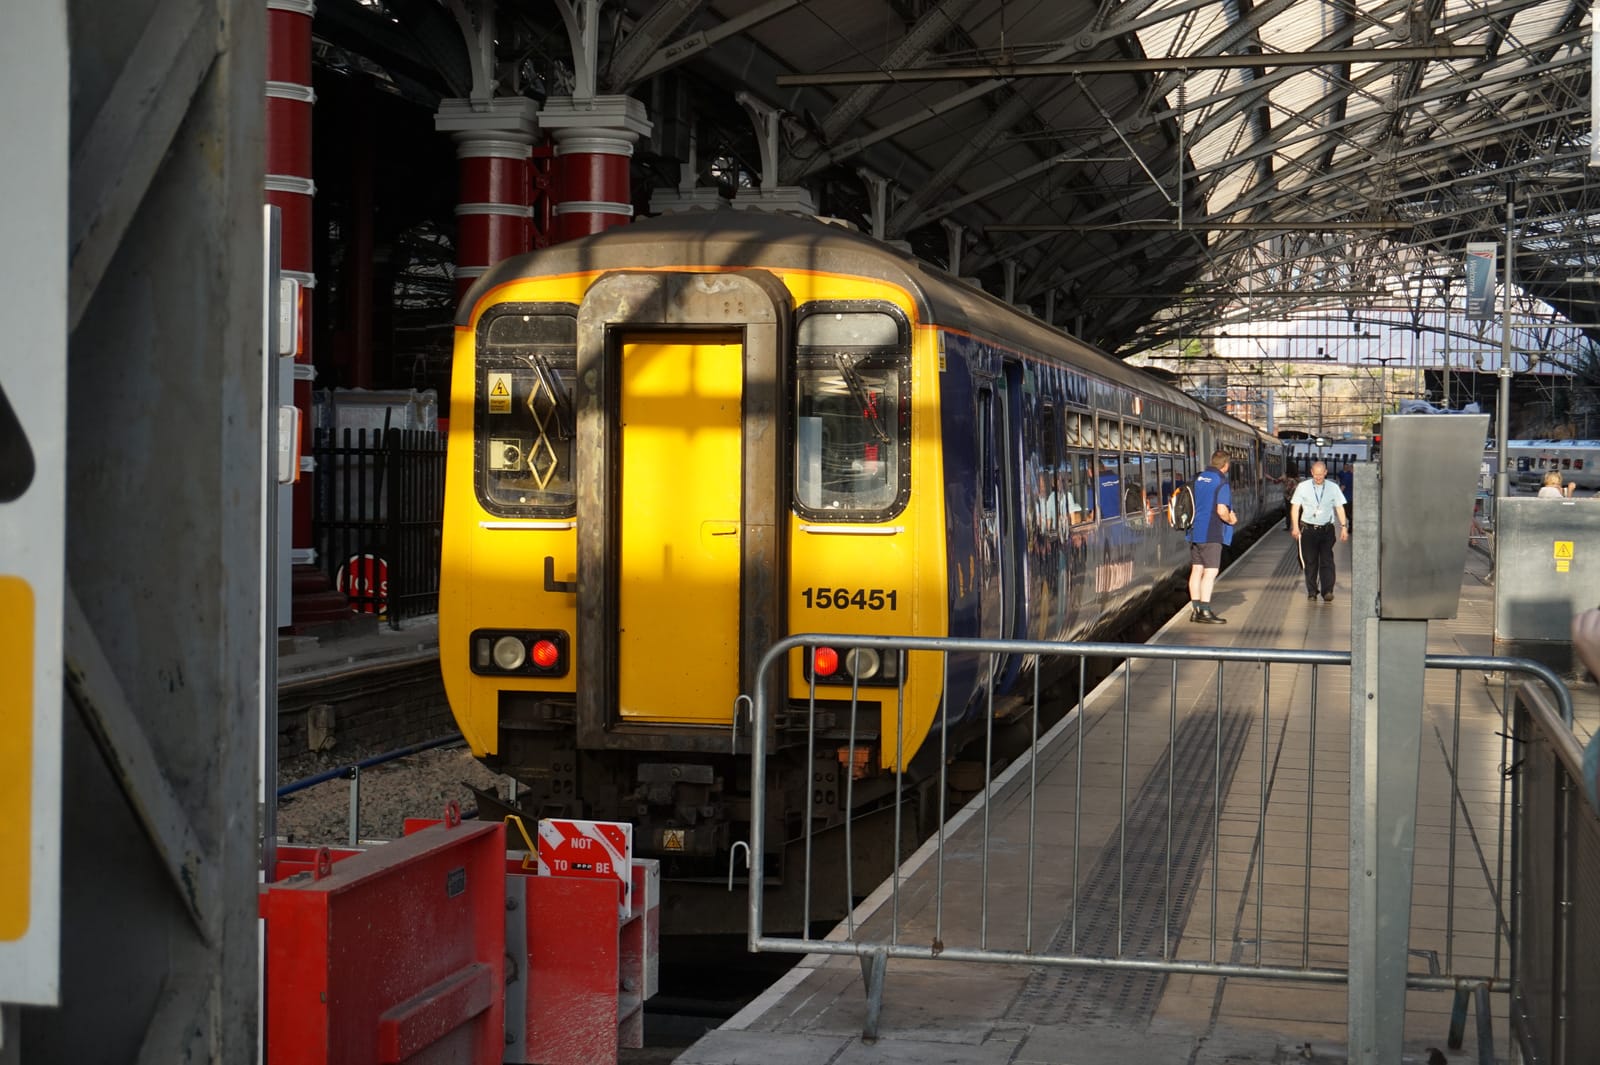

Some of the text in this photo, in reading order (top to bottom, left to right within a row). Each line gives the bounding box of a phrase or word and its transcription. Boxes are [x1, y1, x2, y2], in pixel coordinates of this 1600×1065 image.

[802, 587, 897, 611] 156451
[571, 838, 592, 849] NOT
[554, 860, 568, 871] TO
[595, 862, 610, 874] BE
